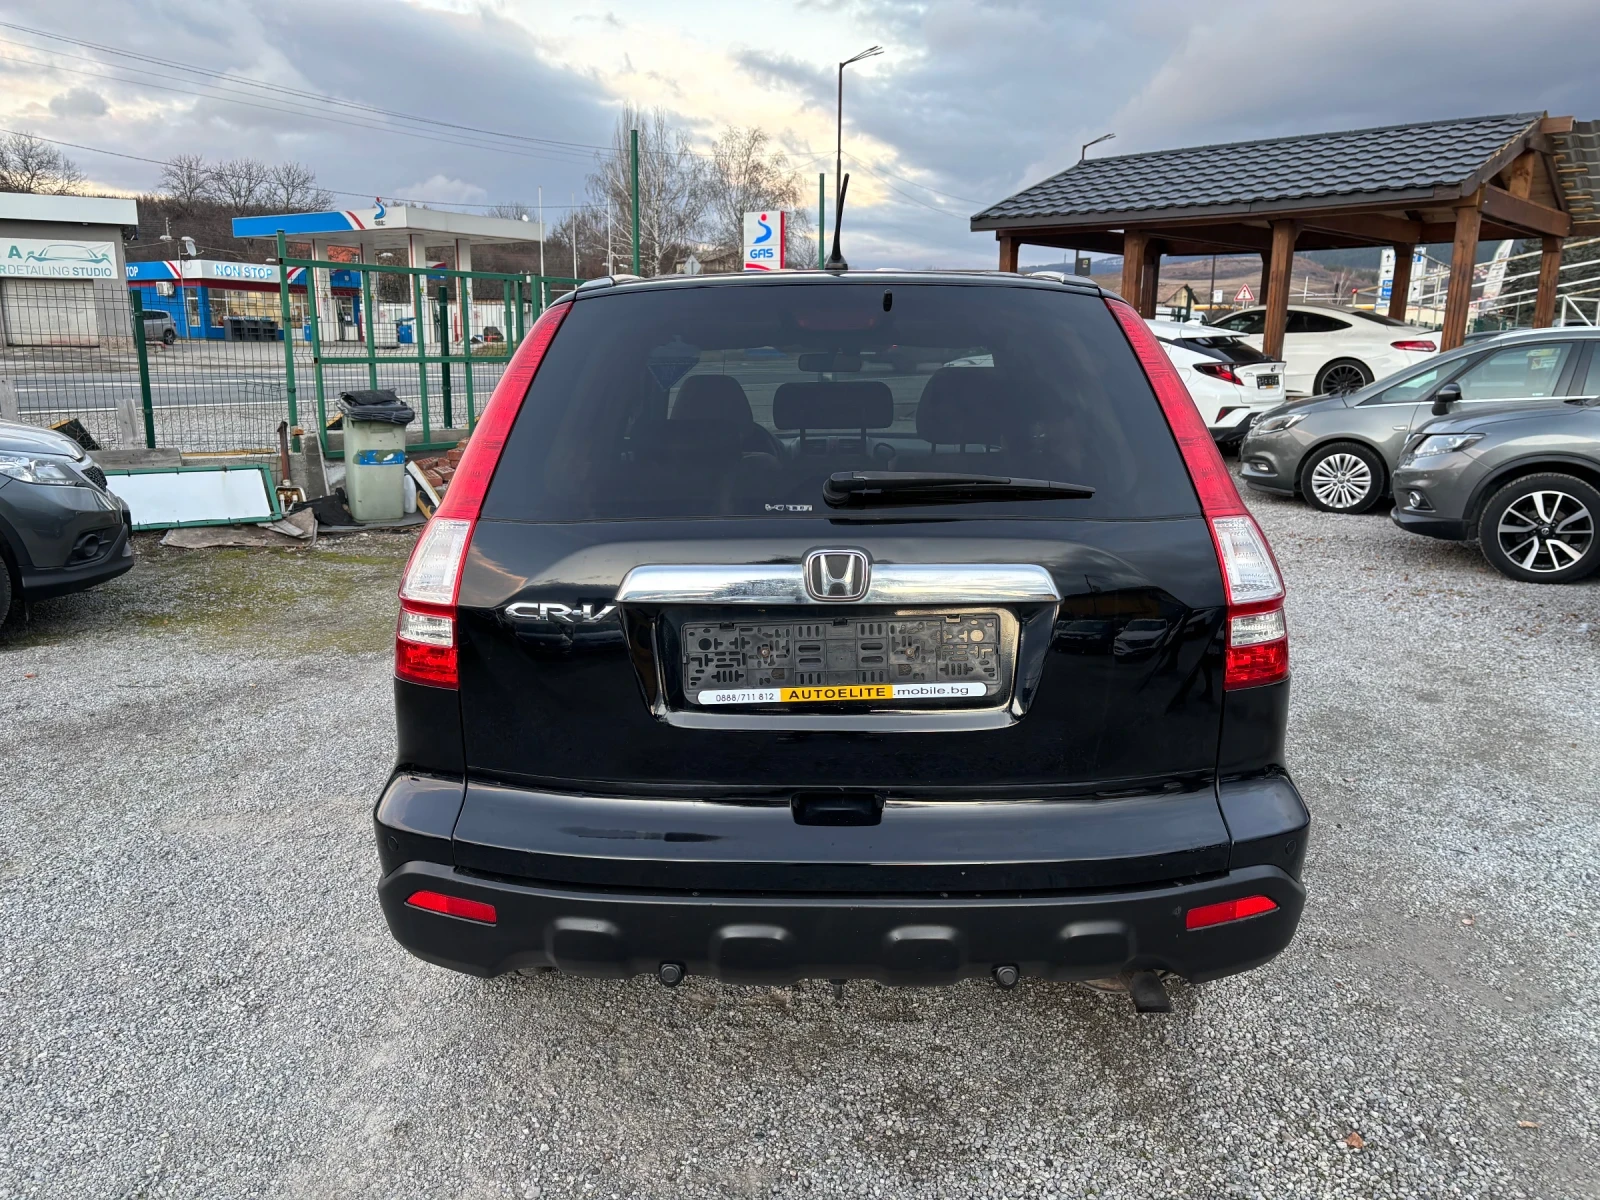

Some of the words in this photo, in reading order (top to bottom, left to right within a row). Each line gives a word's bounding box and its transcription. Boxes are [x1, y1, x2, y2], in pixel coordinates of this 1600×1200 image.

[7, 245, 23, 259] A
[750, 248, 774, 259] GAS
[72, 266, 112, 277] STUDIO
[214, 263, 240, 276] NON
[243, 266, 273, 279] STOP
[505, 602, 617, 622] CR-V
[715, 692, 756, 703] 0888/711
[758, 692, 774, 701] 812
[788, 687, 886, 700] AUTOELITE
